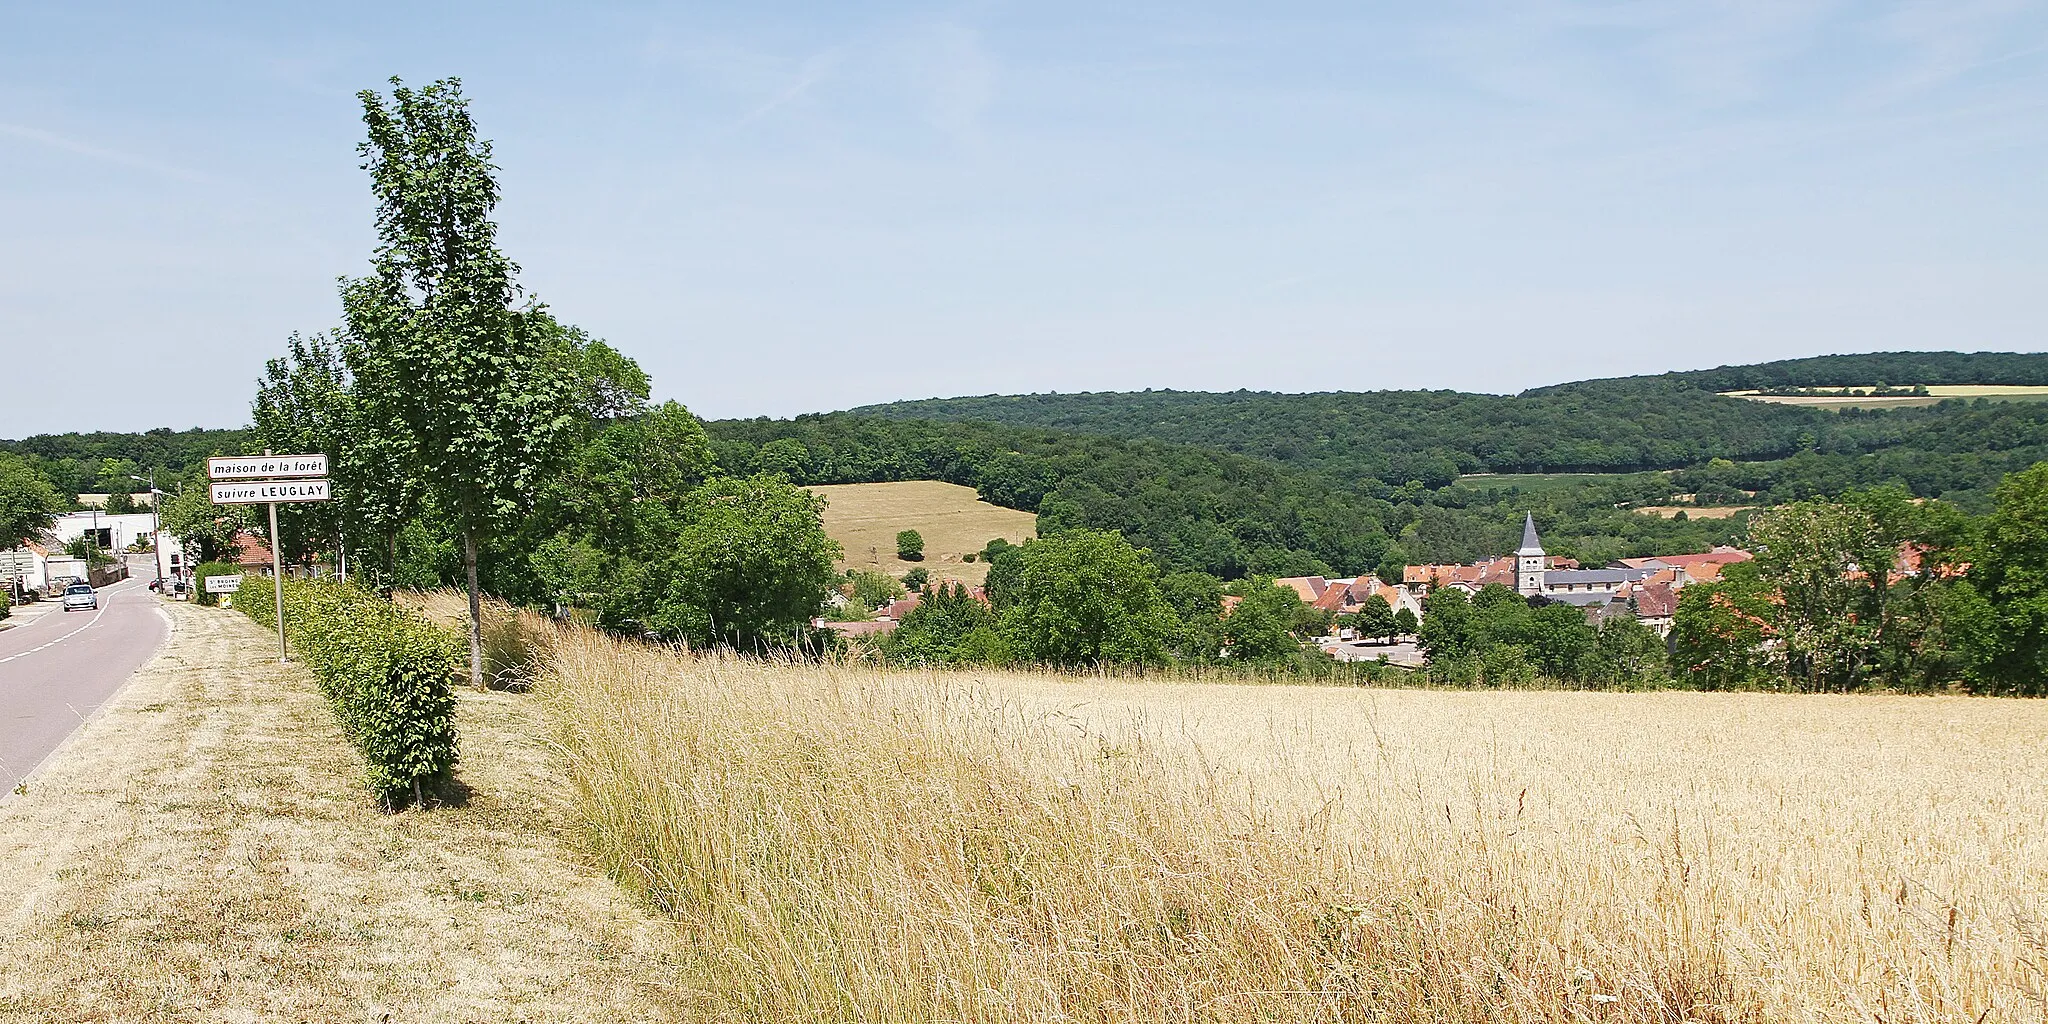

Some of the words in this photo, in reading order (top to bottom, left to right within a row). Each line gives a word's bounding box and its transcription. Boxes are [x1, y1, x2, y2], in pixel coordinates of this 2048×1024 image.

[214, 463, 257, 474] maison
[261, 462, 275, 472] de
[279, 461, 290, 472] la
[294, 460, 322, 471] forêt
[217, 488, 256, 499] suivre
[261, 485, 323, 497] LEUGLAY
